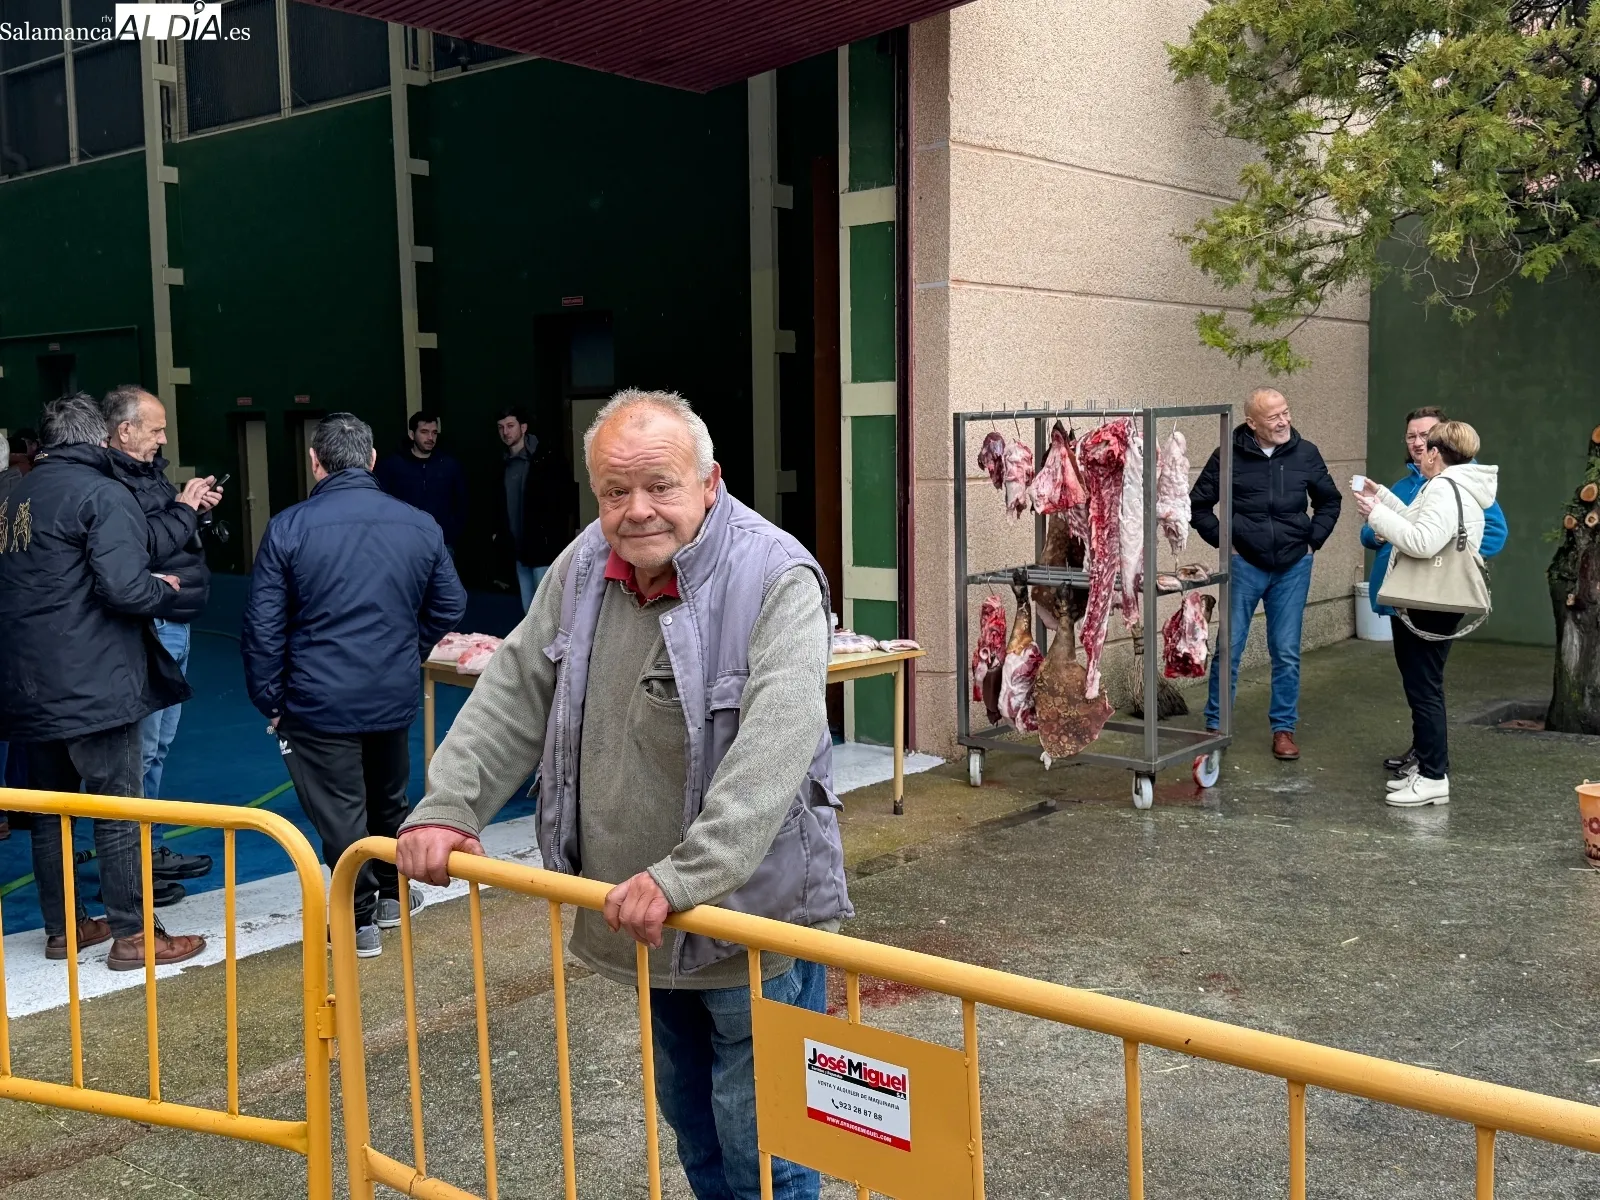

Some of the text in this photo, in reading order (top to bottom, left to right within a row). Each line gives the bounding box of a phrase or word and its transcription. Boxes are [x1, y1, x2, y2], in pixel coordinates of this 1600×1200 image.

[1433, 555, 1443, 567] B
[837, 1086, 860, 1097] ALQUILER
[868, 1096, 899, 1110] MAQUINARIA
[839, 1100, 851, 1110] 923
[853, 1105, 862, 1114] 28
[863, 1109, 872, 1117] 87
